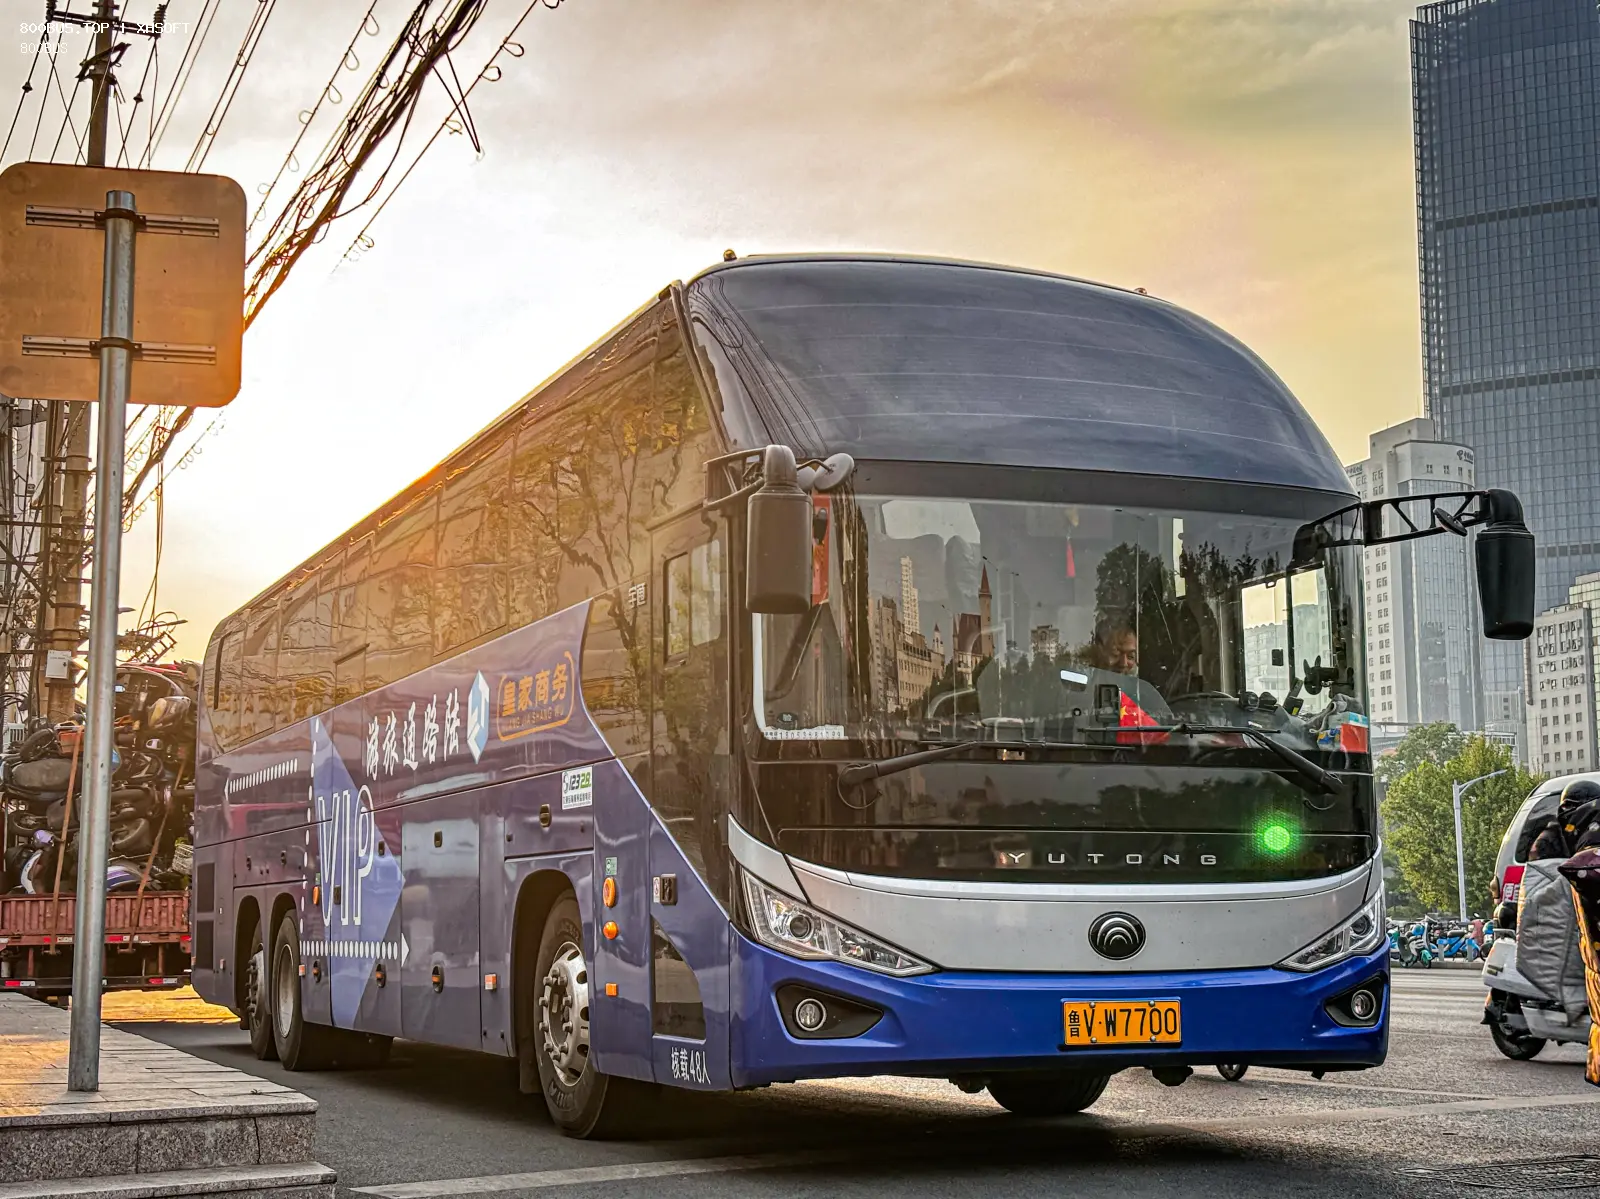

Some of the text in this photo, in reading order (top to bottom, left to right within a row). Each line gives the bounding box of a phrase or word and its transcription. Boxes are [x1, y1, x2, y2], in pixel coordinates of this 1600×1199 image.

[628, 582, 646, 608] 宇通
[502, 663, 568, 717] 皇家商务
[569, 771, 592, 791] 12328
[317, 785, 375, 927] VIP
[1008, 852, 1217, 866] YUTONG
[671, 1046, 712, 1085] 核载48人
